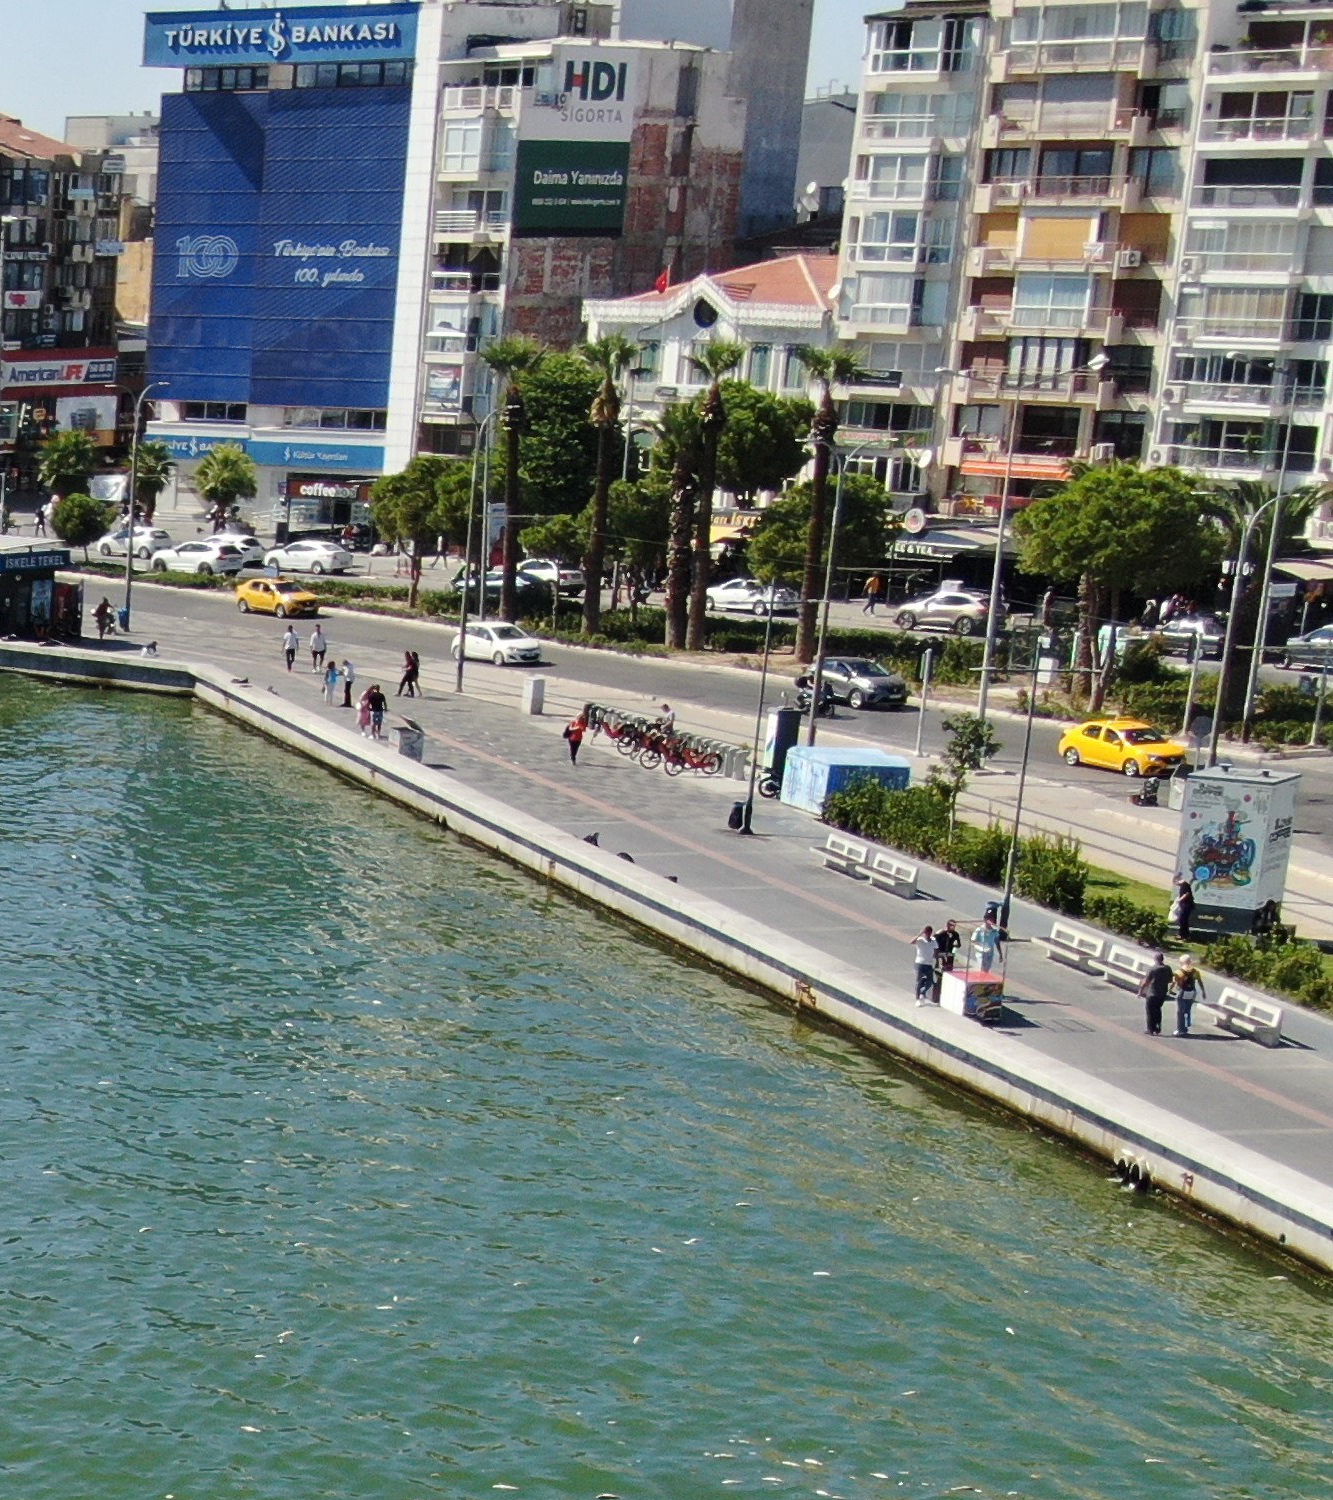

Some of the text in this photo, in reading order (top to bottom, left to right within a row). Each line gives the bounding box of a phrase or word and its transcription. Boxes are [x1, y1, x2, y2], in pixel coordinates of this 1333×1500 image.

[165, 24, 263, 47] TÜRKİYE
[291, 23, 395, 43] BANKASI
[564, 60, 627, 101] HDI
[533, 169, 623, 186] Daima Yanınızda
[176, 234, 239, 278] 100
[294, 268, 320, 283] 100.
[5, 555, 66, 569] İSKELE TEKEL
